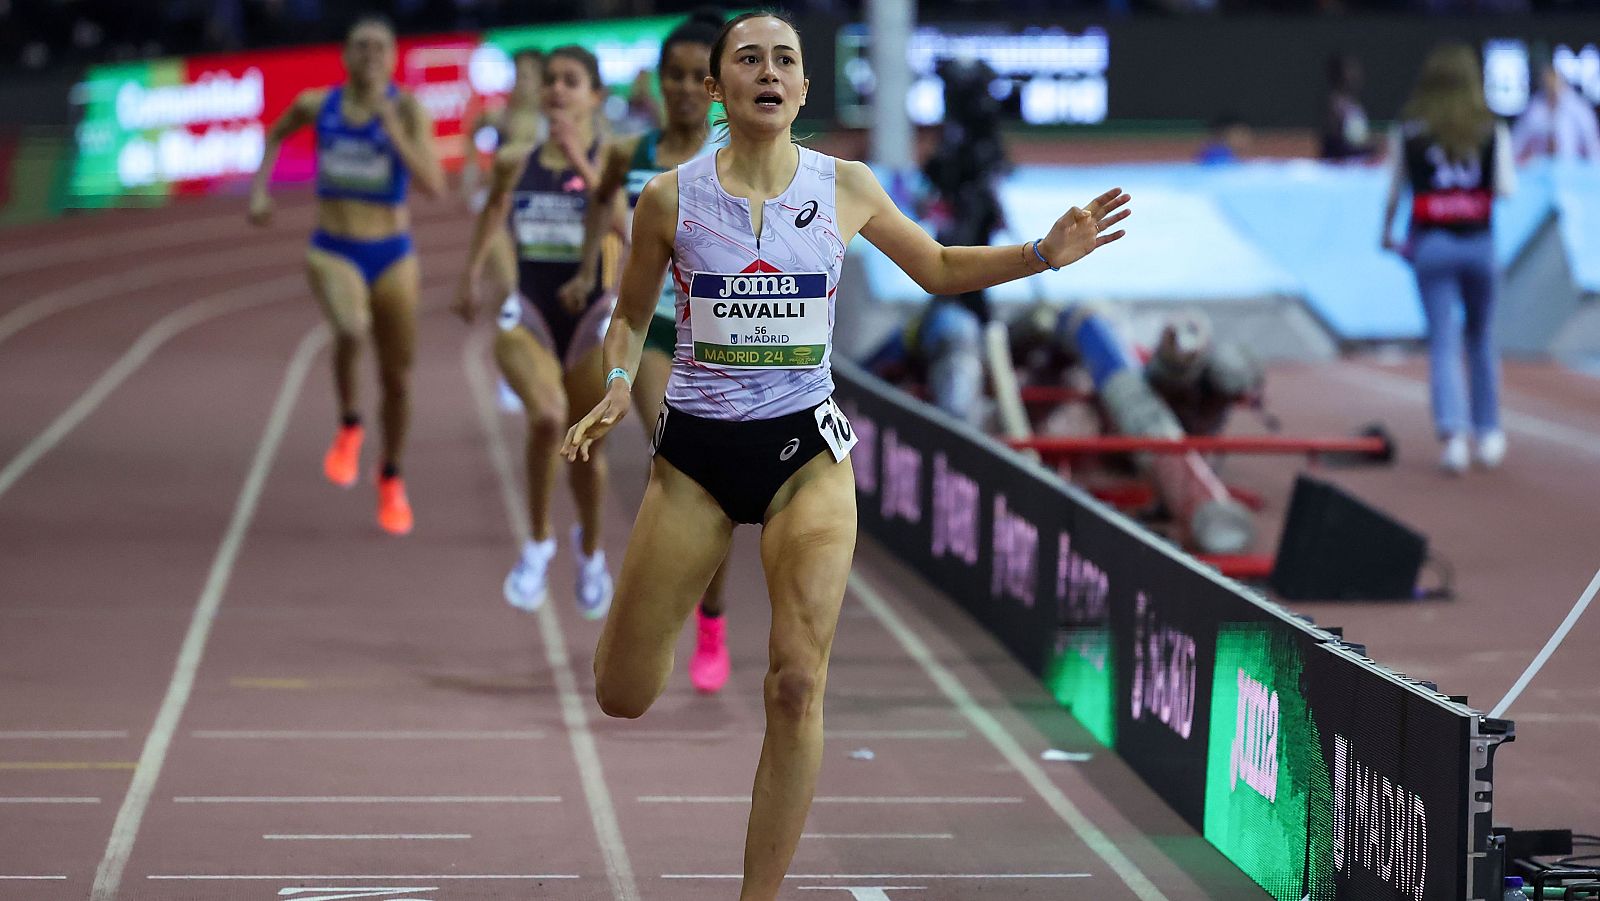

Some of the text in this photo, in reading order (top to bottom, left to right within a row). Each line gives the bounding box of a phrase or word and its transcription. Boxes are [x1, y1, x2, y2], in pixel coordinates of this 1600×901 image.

[719, 276, 799, 298] Joma
[713, 302, 805, 319] CAVALLI
[754, 326, 767, 335] 56
[744, 334, 790, 344] MADRID
[704, 348, 760, 363] MADRID
[764, 350, 784, 363] 24
[1354, 761, 1428, 901] MADRID
